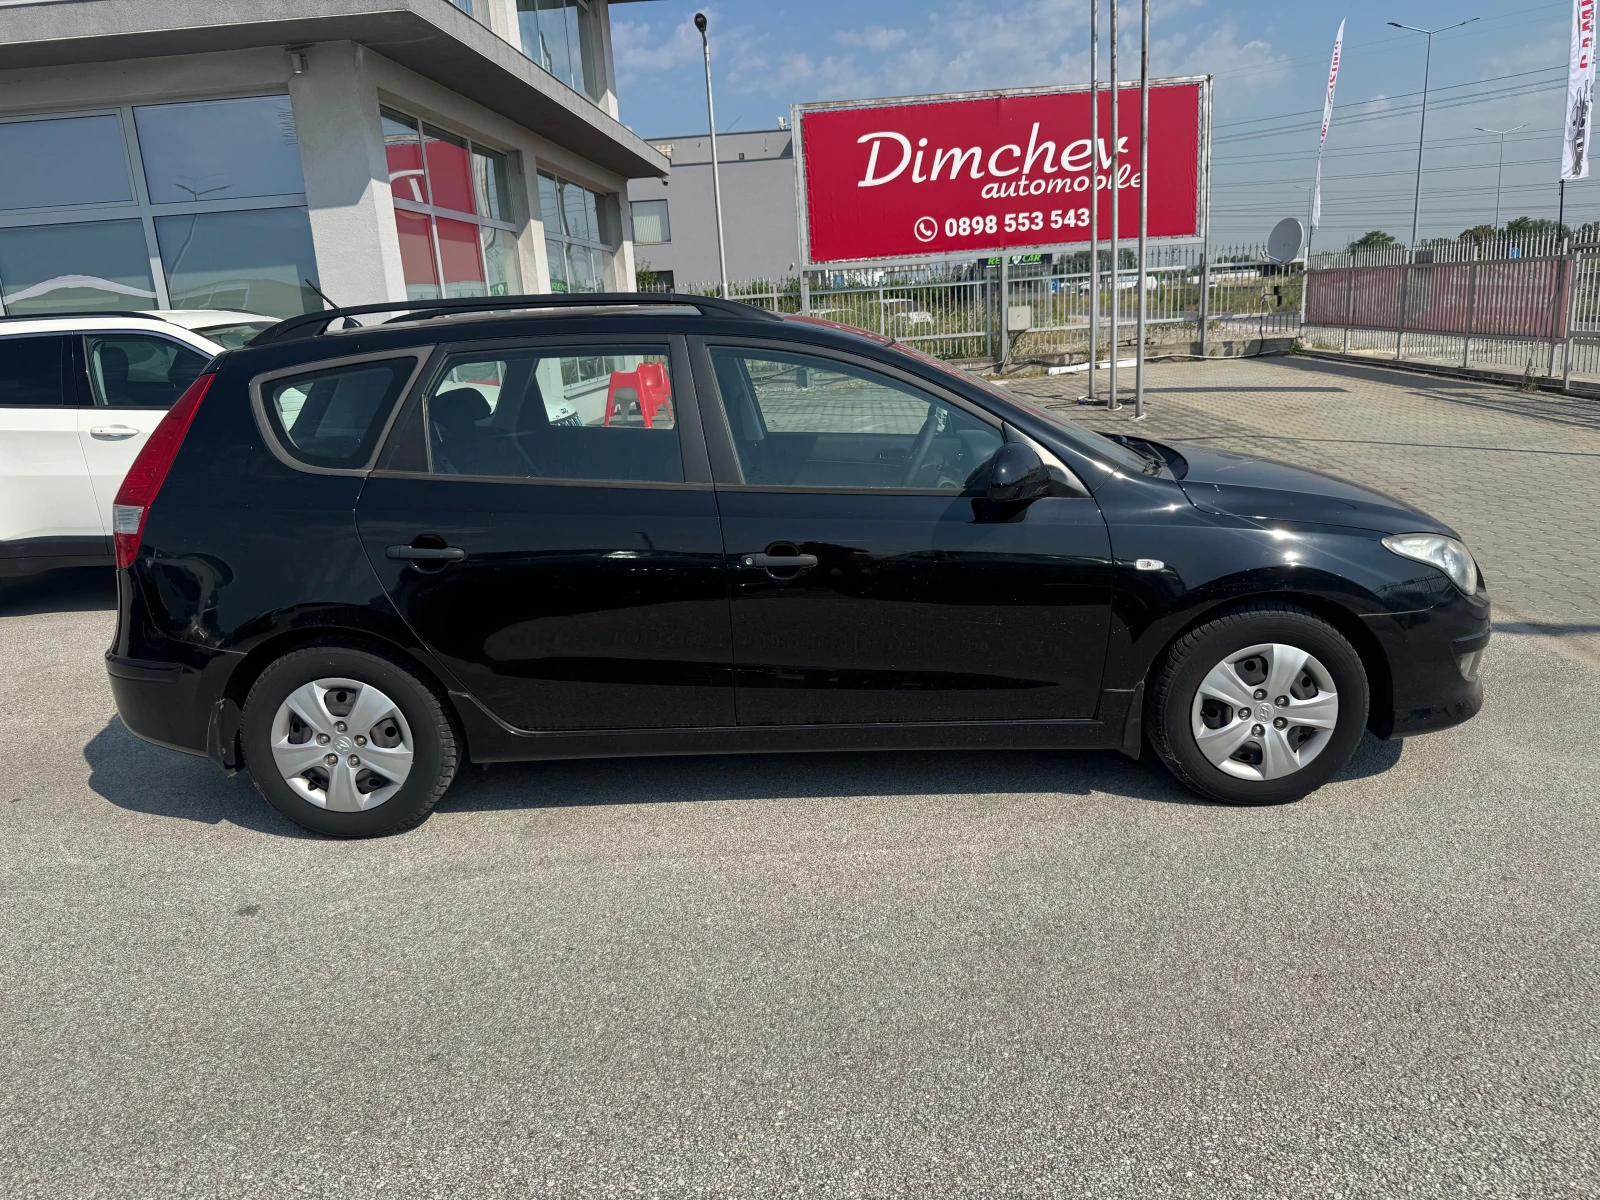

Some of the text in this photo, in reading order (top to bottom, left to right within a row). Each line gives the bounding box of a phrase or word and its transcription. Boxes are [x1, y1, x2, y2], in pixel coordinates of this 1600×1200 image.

[857, 122, 1129, 187] Dimchev
[945, 207, 1090, 237] 0898 553 543
[988, 255, 1012, 265] RET
